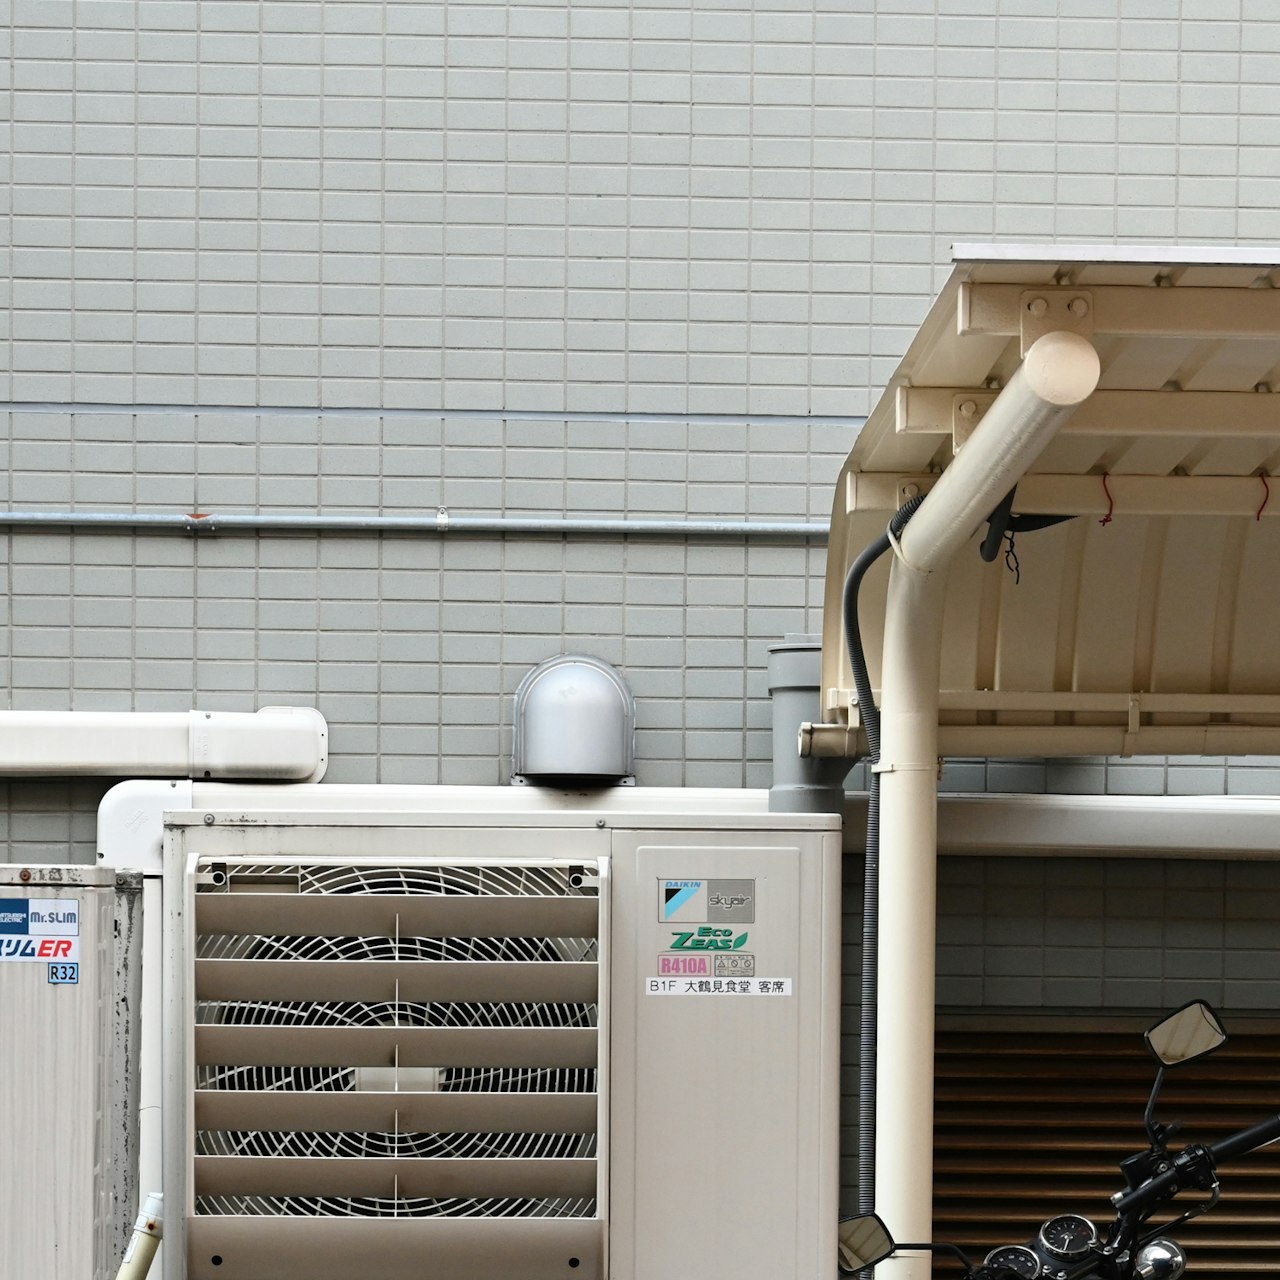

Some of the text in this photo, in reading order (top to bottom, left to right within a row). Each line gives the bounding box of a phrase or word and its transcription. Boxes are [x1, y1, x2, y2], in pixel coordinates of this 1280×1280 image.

[661, 957, 707, 974] R410A
[50, 966, 76, 980] R32
[650, 980, 785, 993] B1F 大鶴見食堂 客席
